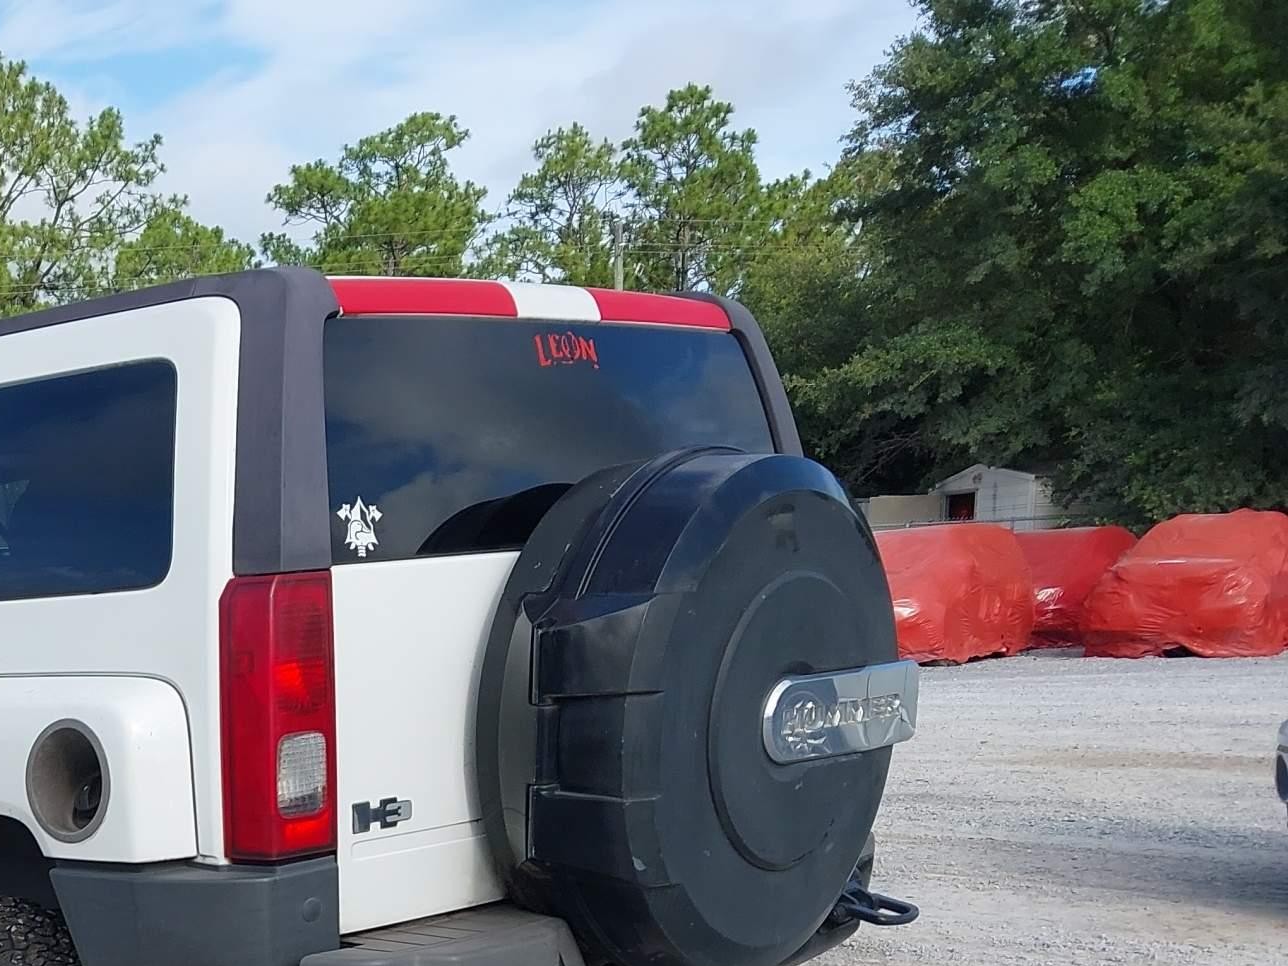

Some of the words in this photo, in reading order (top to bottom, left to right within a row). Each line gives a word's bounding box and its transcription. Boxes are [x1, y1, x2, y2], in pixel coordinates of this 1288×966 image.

[534, 331, 600, 368] LEON
[781, 693, 902, 735] HUMMER
[352, 797, 412, 834] H3
